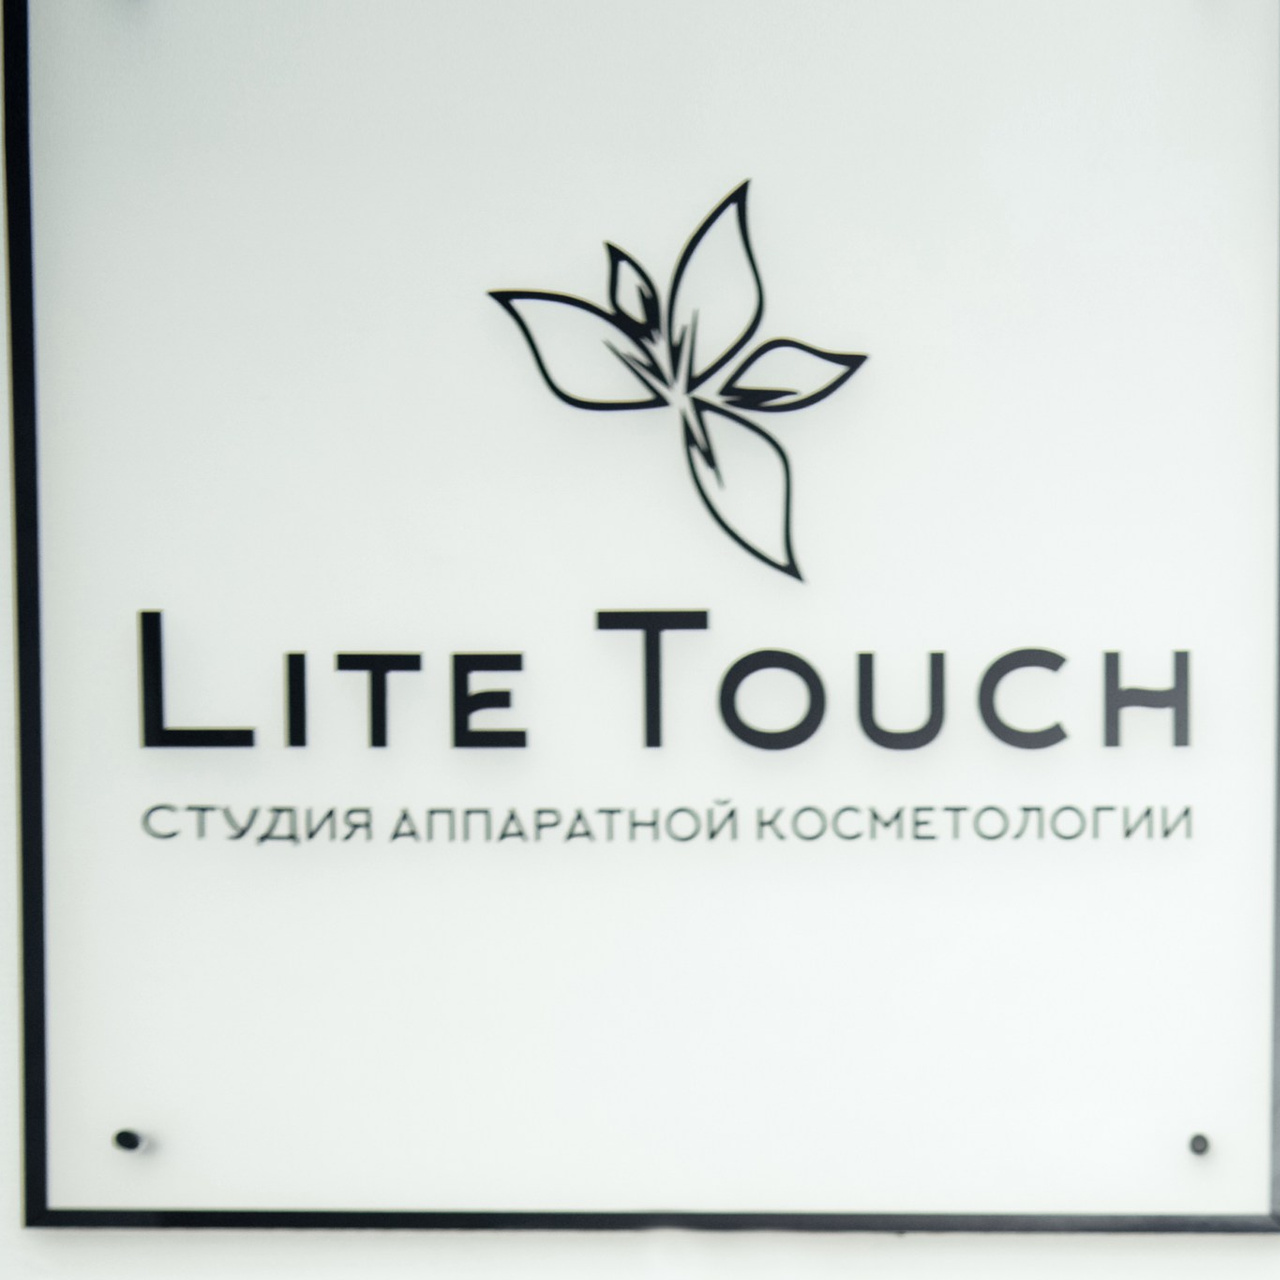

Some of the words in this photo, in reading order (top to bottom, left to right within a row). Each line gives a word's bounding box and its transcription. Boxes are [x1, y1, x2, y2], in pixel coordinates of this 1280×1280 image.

[139, 609, 528, 748] LITE
[595, 609, 1193, 751] TOUCH
[141, 804, 374, 845] СТУДИЯ
[391, 799, 738, 843] АППАРАТНОЙ
[756, 805, 1193, 841] КОСМЕТОЛОГИИ
